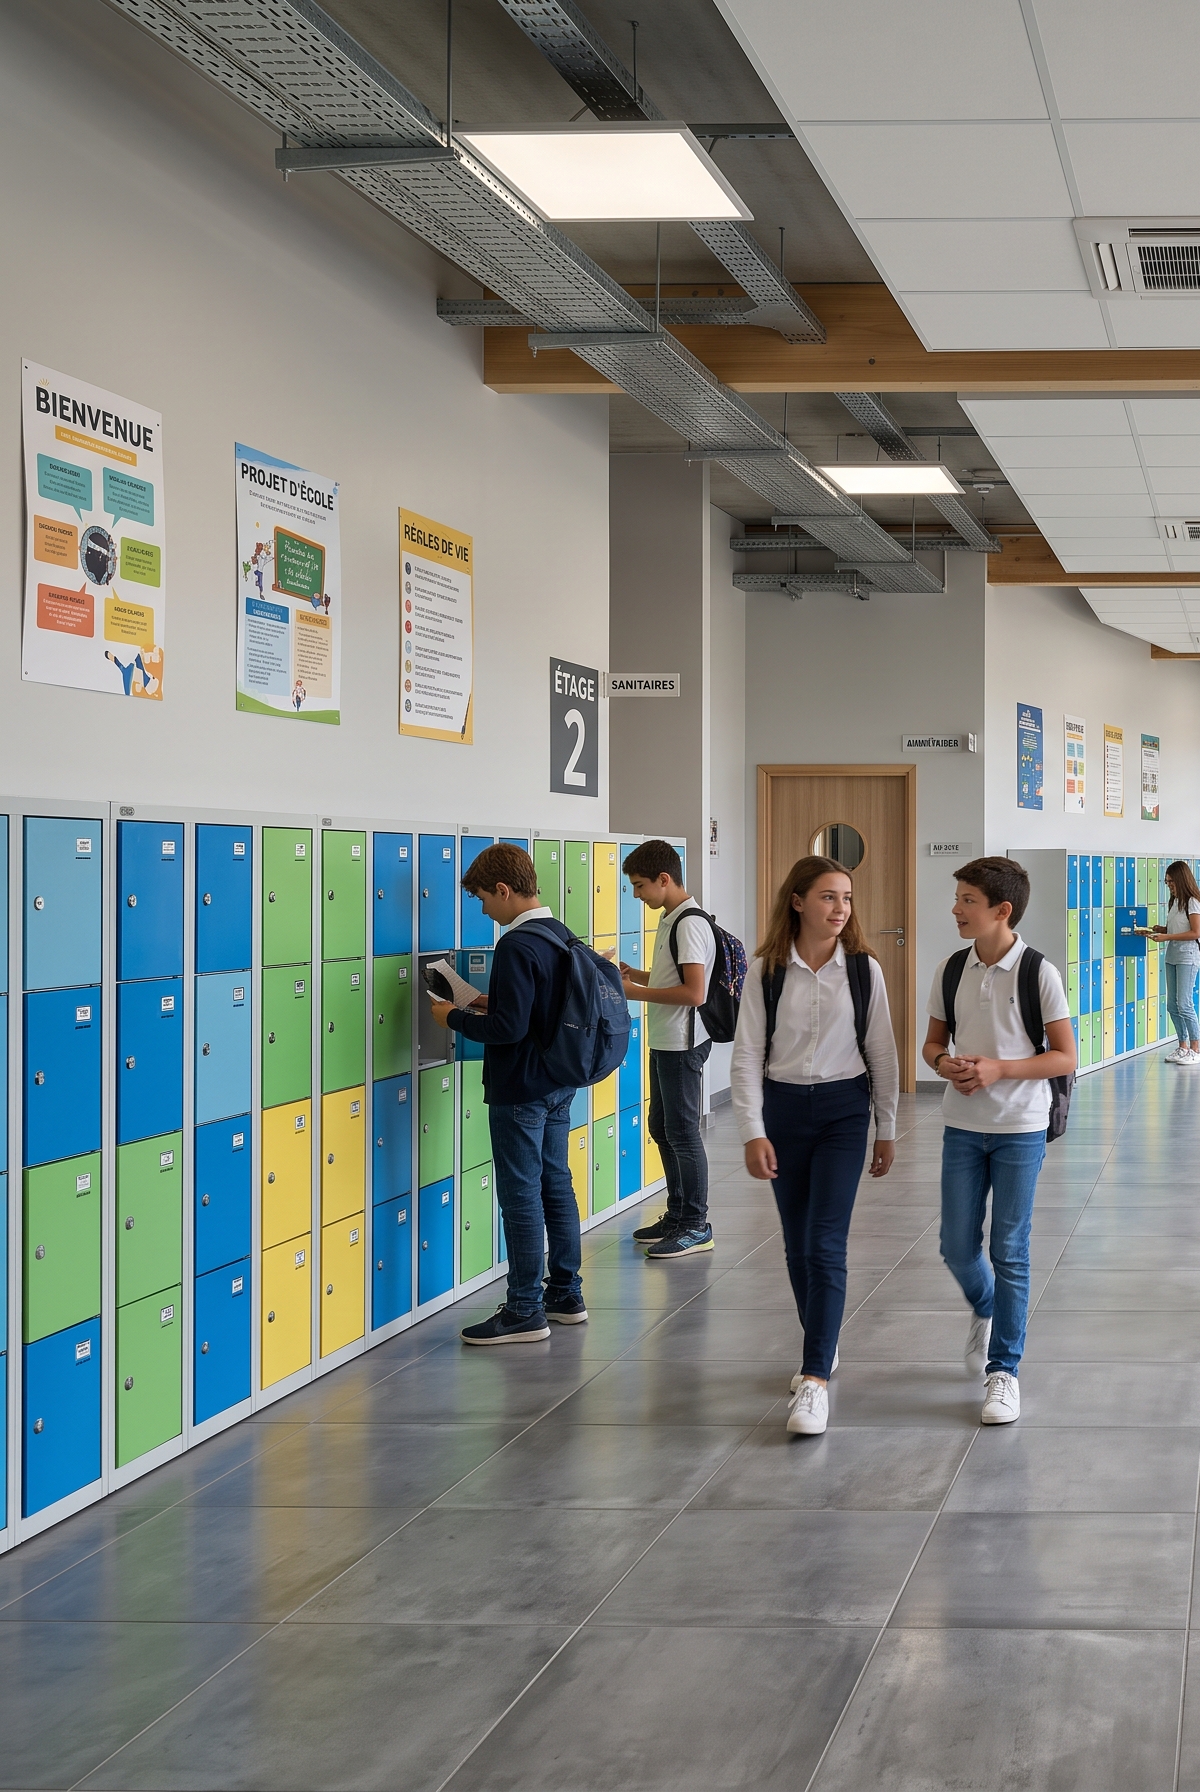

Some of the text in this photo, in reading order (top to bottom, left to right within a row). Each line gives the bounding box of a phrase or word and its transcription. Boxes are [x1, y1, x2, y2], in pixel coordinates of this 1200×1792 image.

[35, 385, 154, 453] BIENVENUE
[240, 462, 287, 495] PROJET
[289, 480, 335, 511] D'ÉCOLE
[441, 538, 454, 556] DE
[454, 544, 469, 563] VIE
[554, 664, 595, 702] ÉTAGE
[611, 680, 675, 690] SANITAIRES
[564, 708, 587, 788] 2
